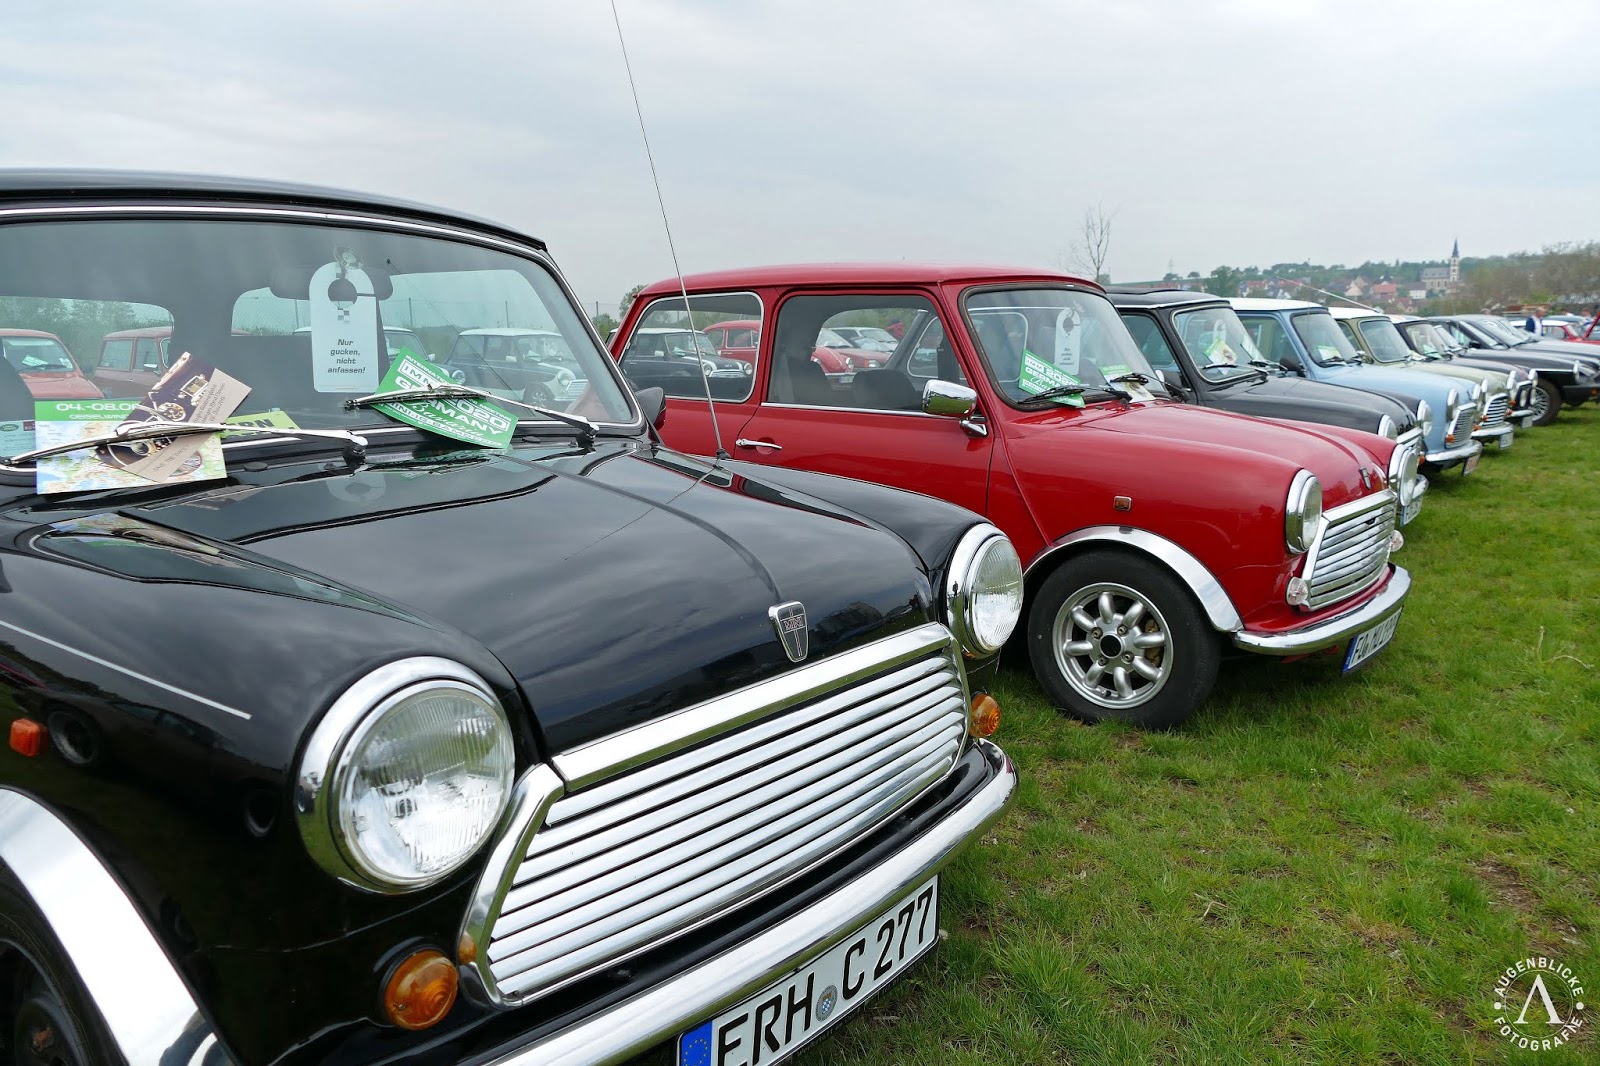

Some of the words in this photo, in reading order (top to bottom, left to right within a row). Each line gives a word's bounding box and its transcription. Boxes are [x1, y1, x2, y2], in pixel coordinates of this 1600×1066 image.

[330, 348, 361, 356] gucken,
[327, 366, 366, 374] anfassen!
[718, 971, 815, 1066] ERH
[842, 937, 866, 1000] C
[873, 883, 934, 981] 277
